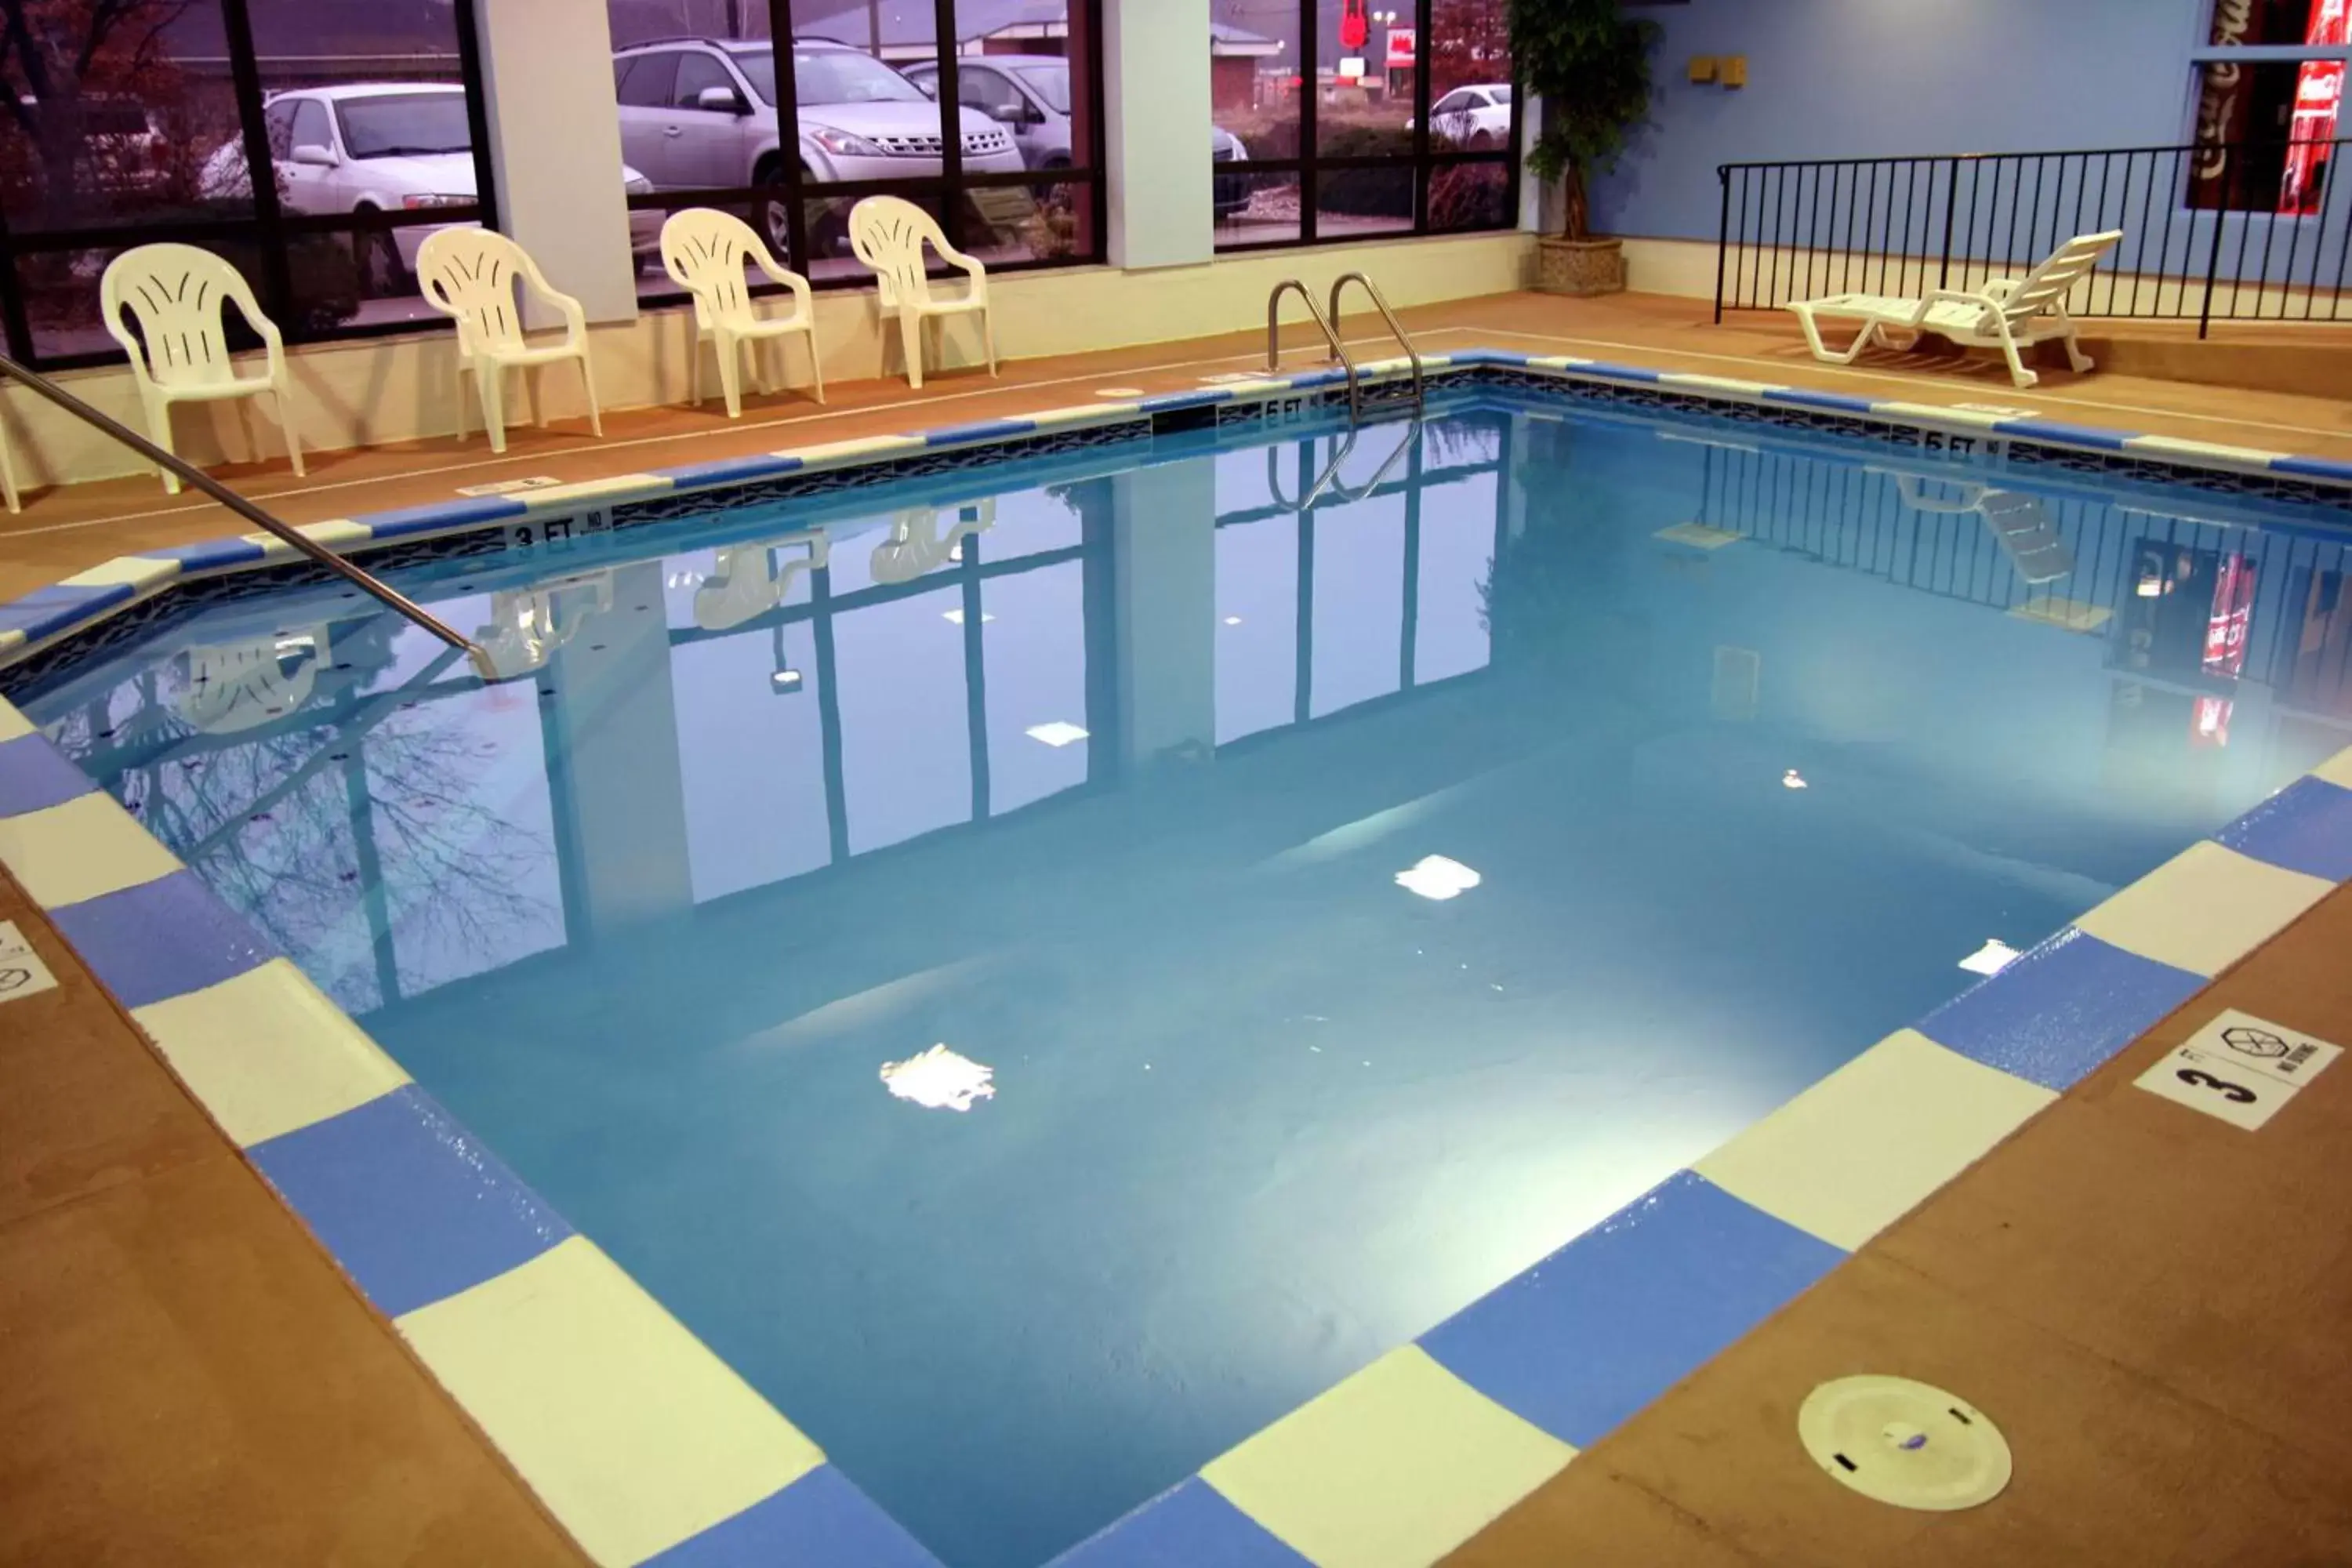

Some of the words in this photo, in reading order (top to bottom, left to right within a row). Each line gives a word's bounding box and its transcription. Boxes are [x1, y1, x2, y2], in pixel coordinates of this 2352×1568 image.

[1950, 436, 1976, 454] FT
[515, 527, 532, 546] 3
[544, 517, 575, 542] FT
[2176, 1069, 2257, 1104] 3
